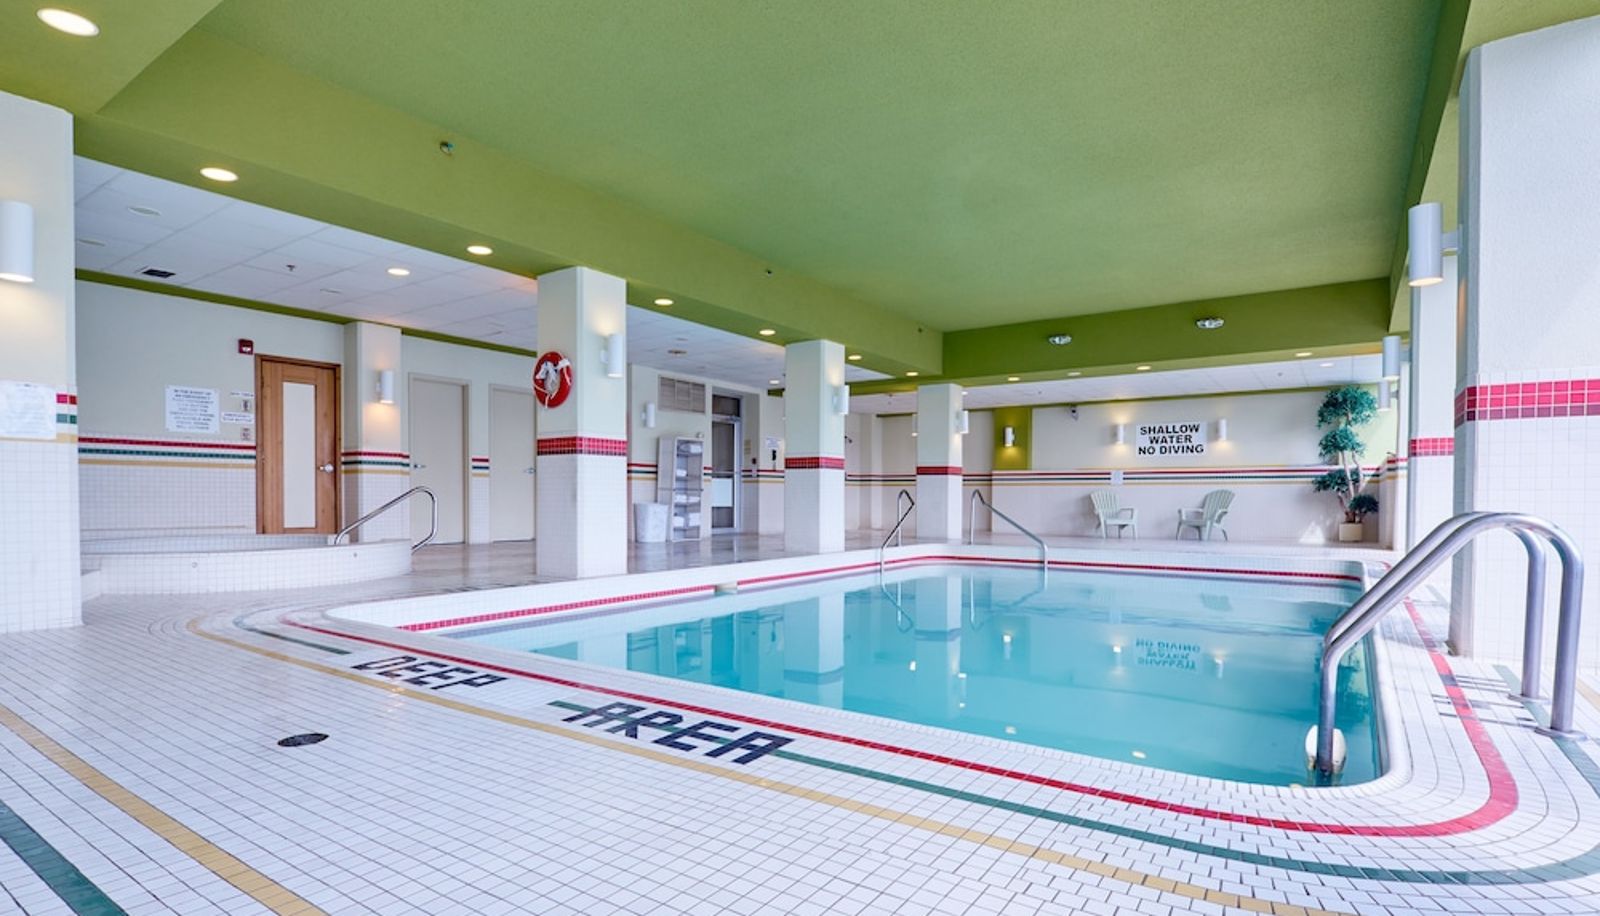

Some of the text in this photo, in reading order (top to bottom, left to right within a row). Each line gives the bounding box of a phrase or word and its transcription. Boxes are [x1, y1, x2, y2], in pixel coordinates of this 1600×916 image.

[1140, 424, 1200, 435] SHALLOW
[1149, 434, 1193, 444] WATER
[1138, 444, 1204, 455] NO DIVING
[351, 655, 795, 766] DEEP AREA
